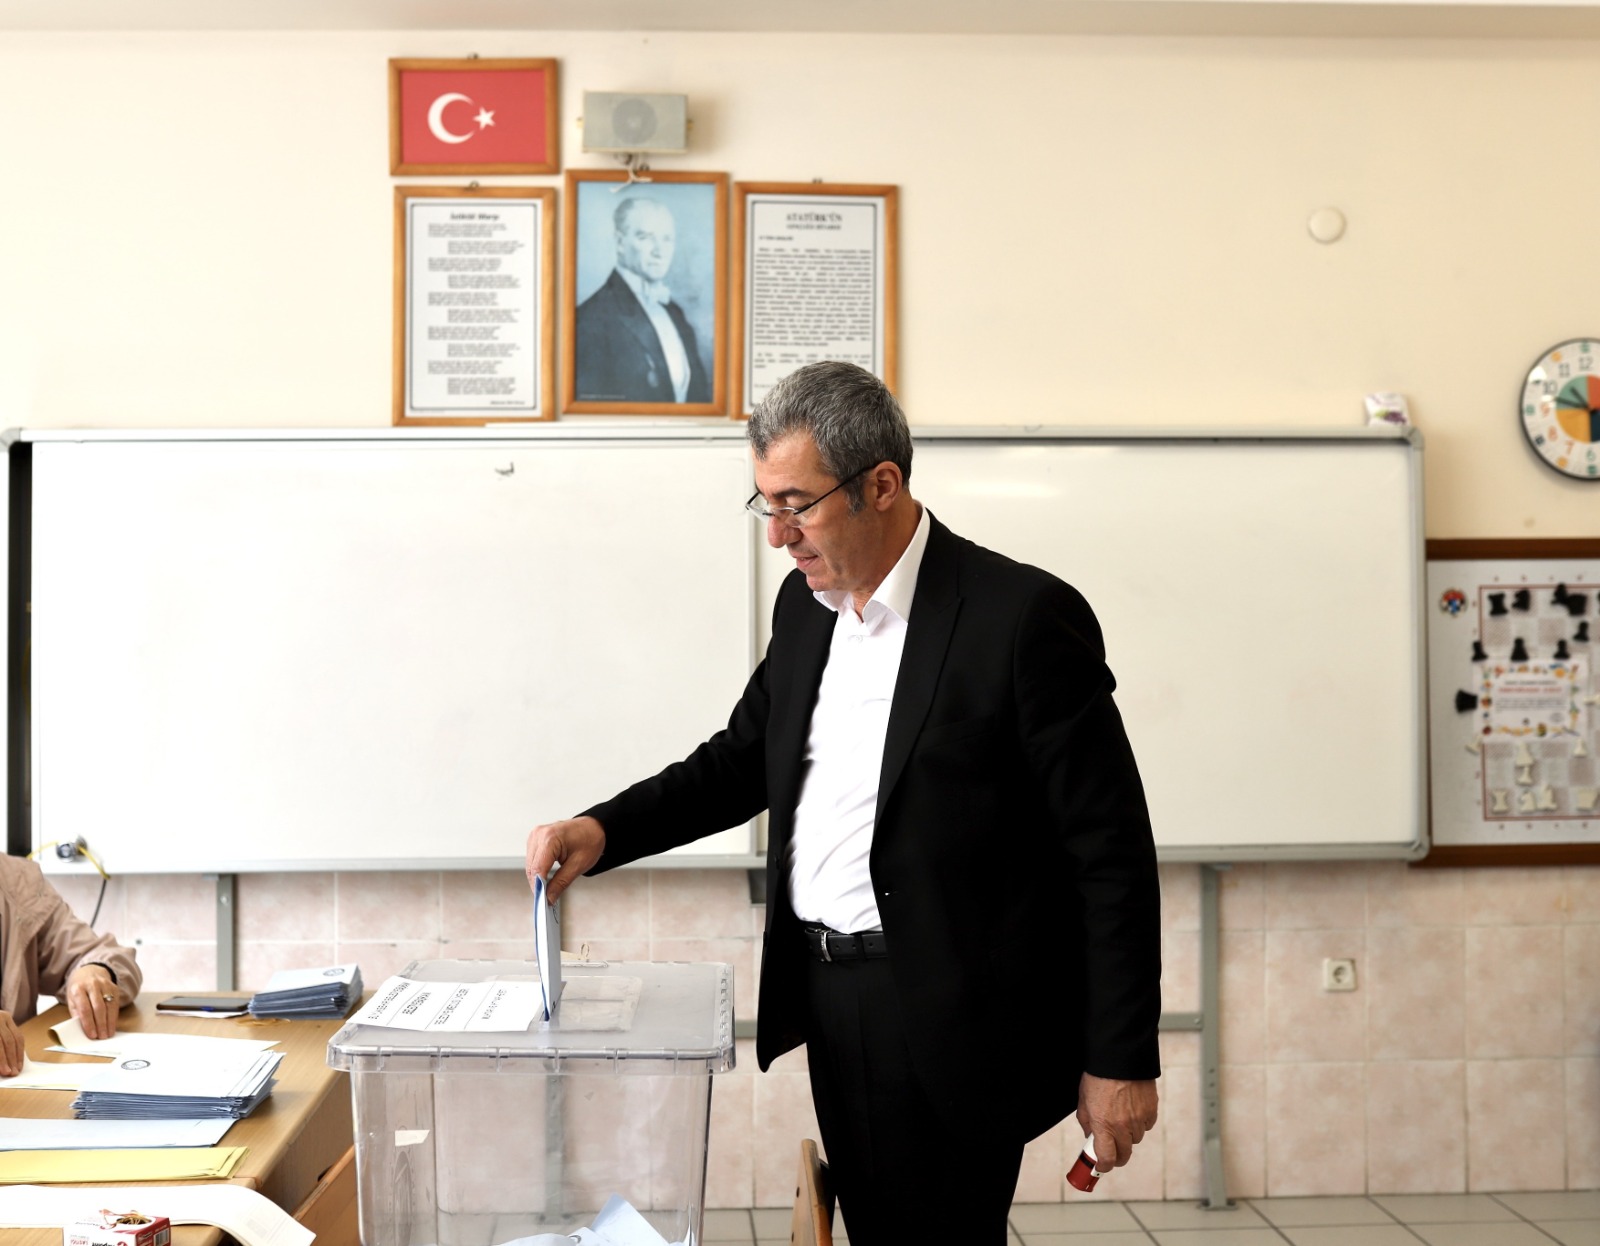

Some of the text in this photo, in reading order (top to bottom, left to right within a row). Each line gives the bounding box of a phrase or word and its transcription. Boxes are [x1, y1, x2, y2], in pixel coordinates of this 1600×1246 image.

[1559, 363, 1571, 378] 11
[1578, 355, 1593, 371] 12
[1543, 380, 1558, 395] 10
[1565, 440, 1575, 455] 7
[1586, 446, 1596, 462] 6
